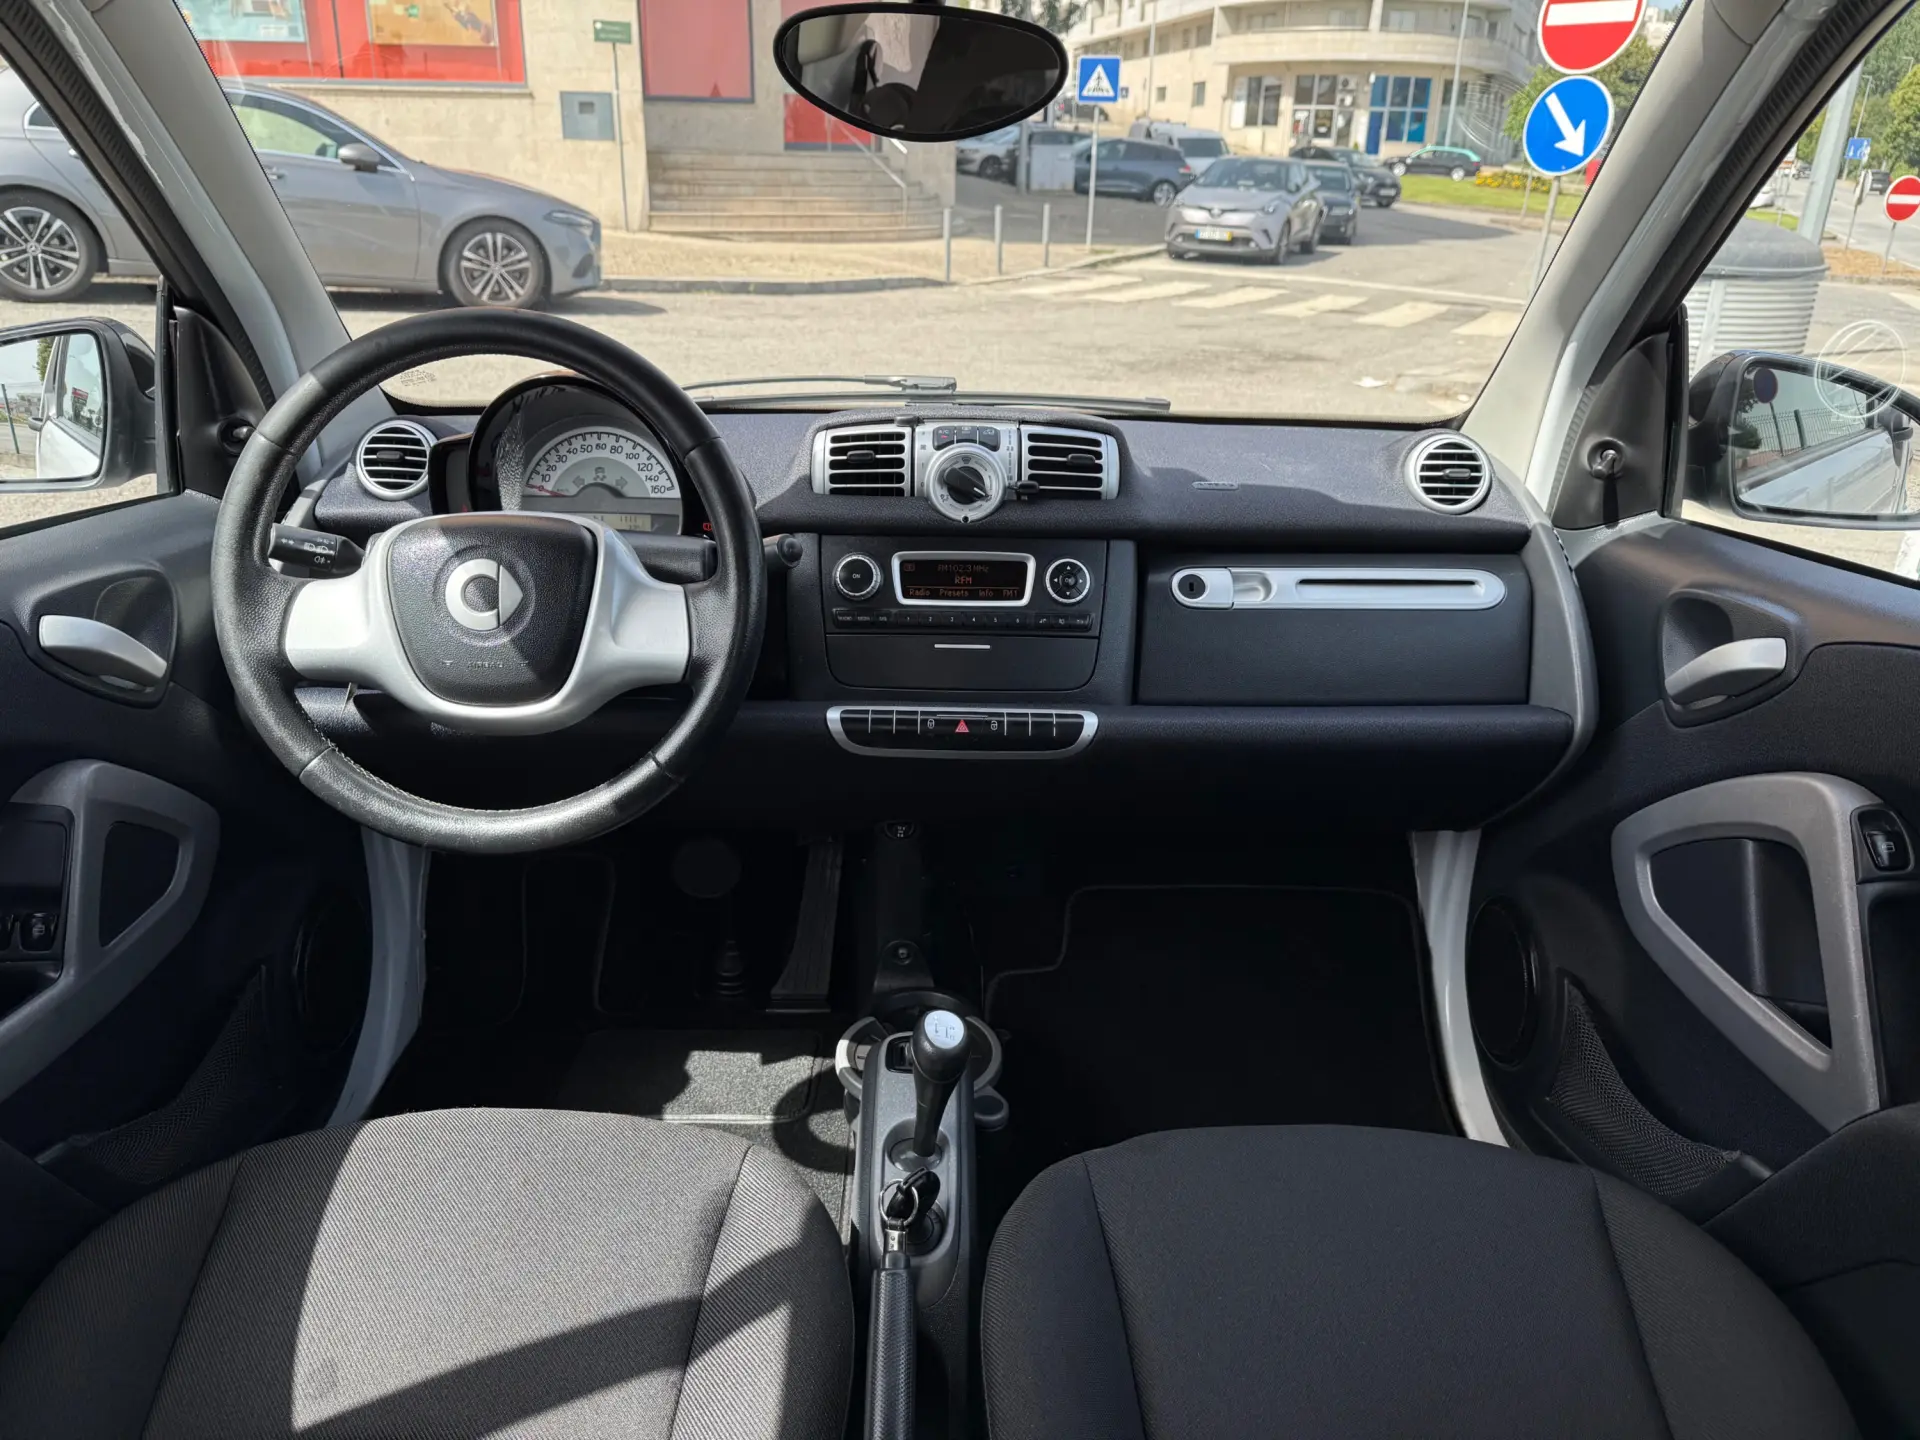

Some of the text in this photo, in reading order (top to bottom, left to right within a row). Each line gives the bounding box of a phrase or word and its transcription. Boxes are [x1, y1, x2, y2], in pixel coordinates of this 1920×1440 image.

[566, 447, 578, 455] 40
[579, 444, 594, 454] 50
[595, 443, 607, 451] 60
[609, 445, 624, 454] 80
[555, 454, 568, 463] 30
[625, 452, 640, 460] 100
[546, 464, 557, 472] 20
[637, 462, 653, 472] 120
[540, 473, 551, 483] 10
[644, 474, 659, 482] 140
[650, 484, 667, 494] 160
[954, 576, 972, 584] RFM
[909, 588, 931, 596] Radio
[939, 588, 969, 597] Presets
[978, 589, 994, 597] Info
